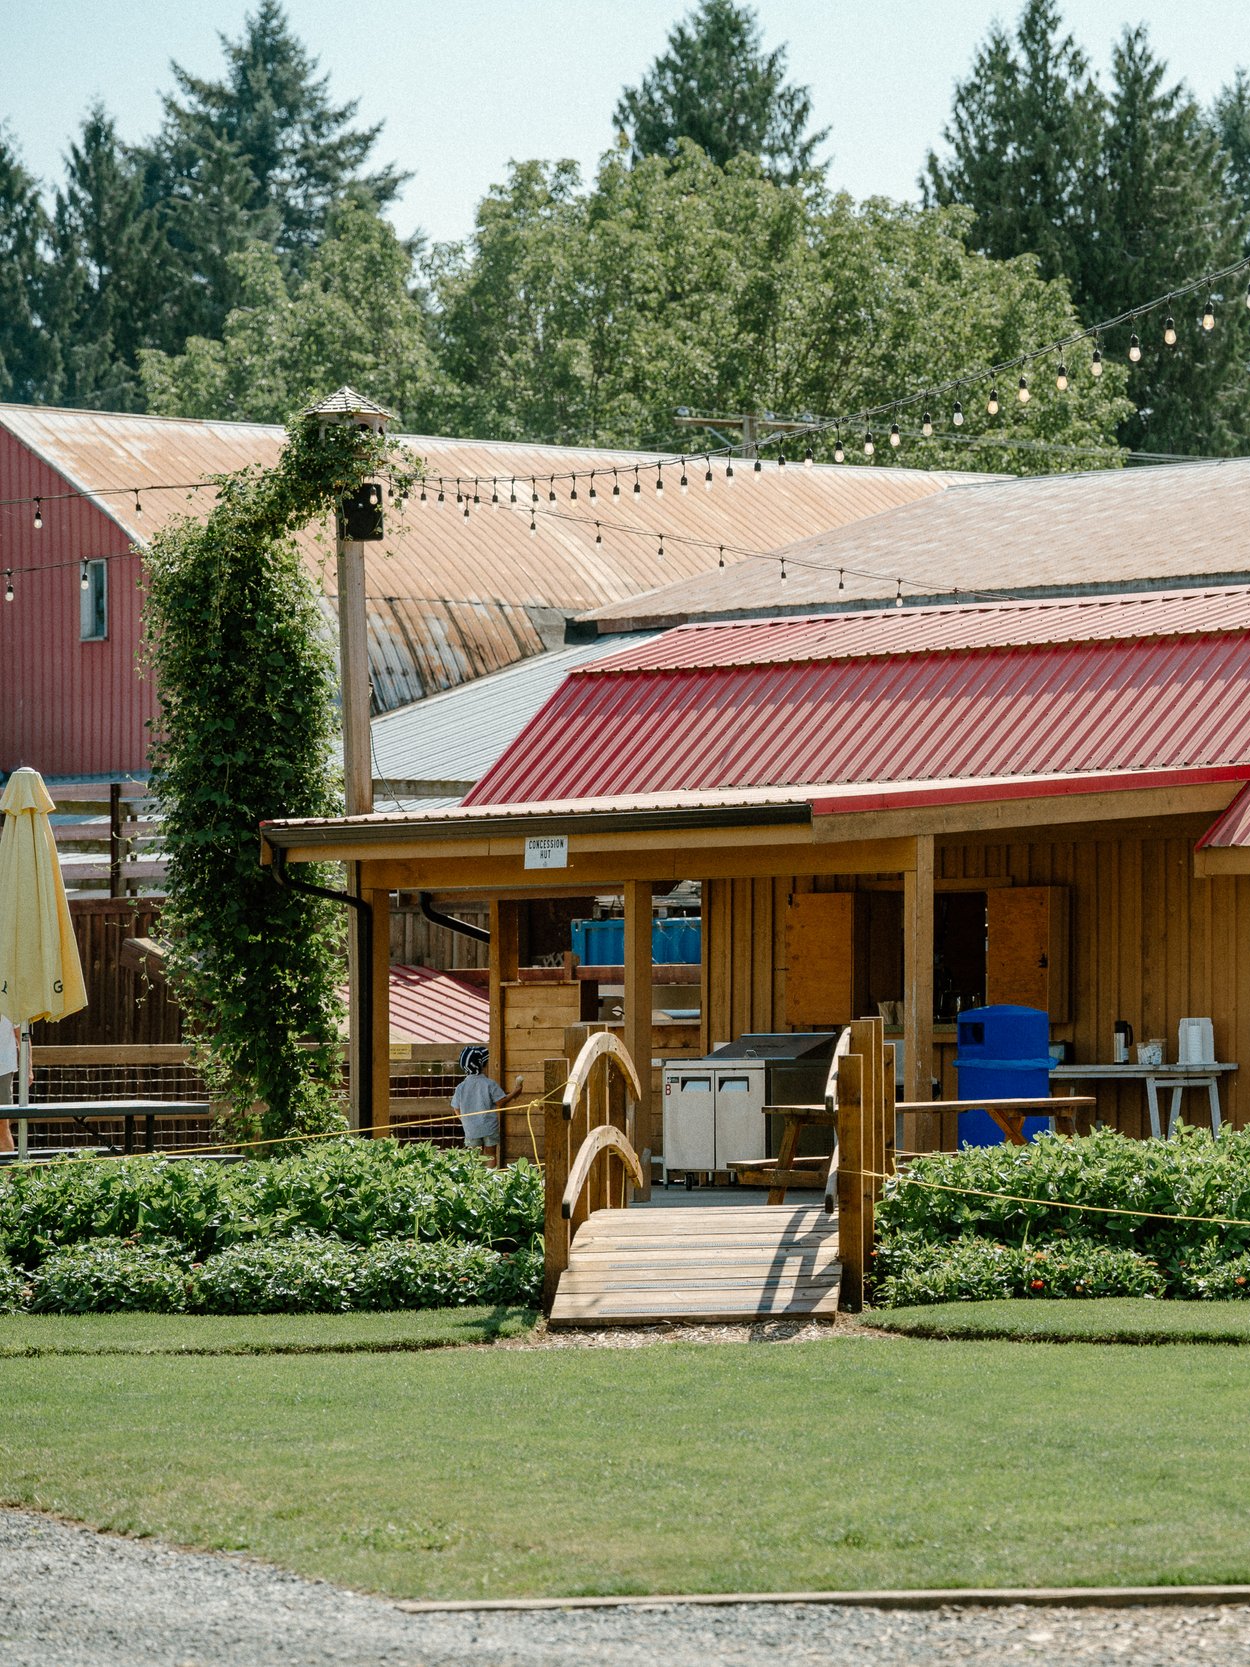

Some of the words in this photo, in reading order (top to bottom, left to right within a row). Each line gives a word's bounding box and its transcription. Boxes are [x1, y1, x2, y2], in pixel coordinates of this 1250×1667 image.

[528, 839, 564, 849] CONCESSION
[540, 849, 551, 858] HUT
[665, 1084, 672, 1096] B
